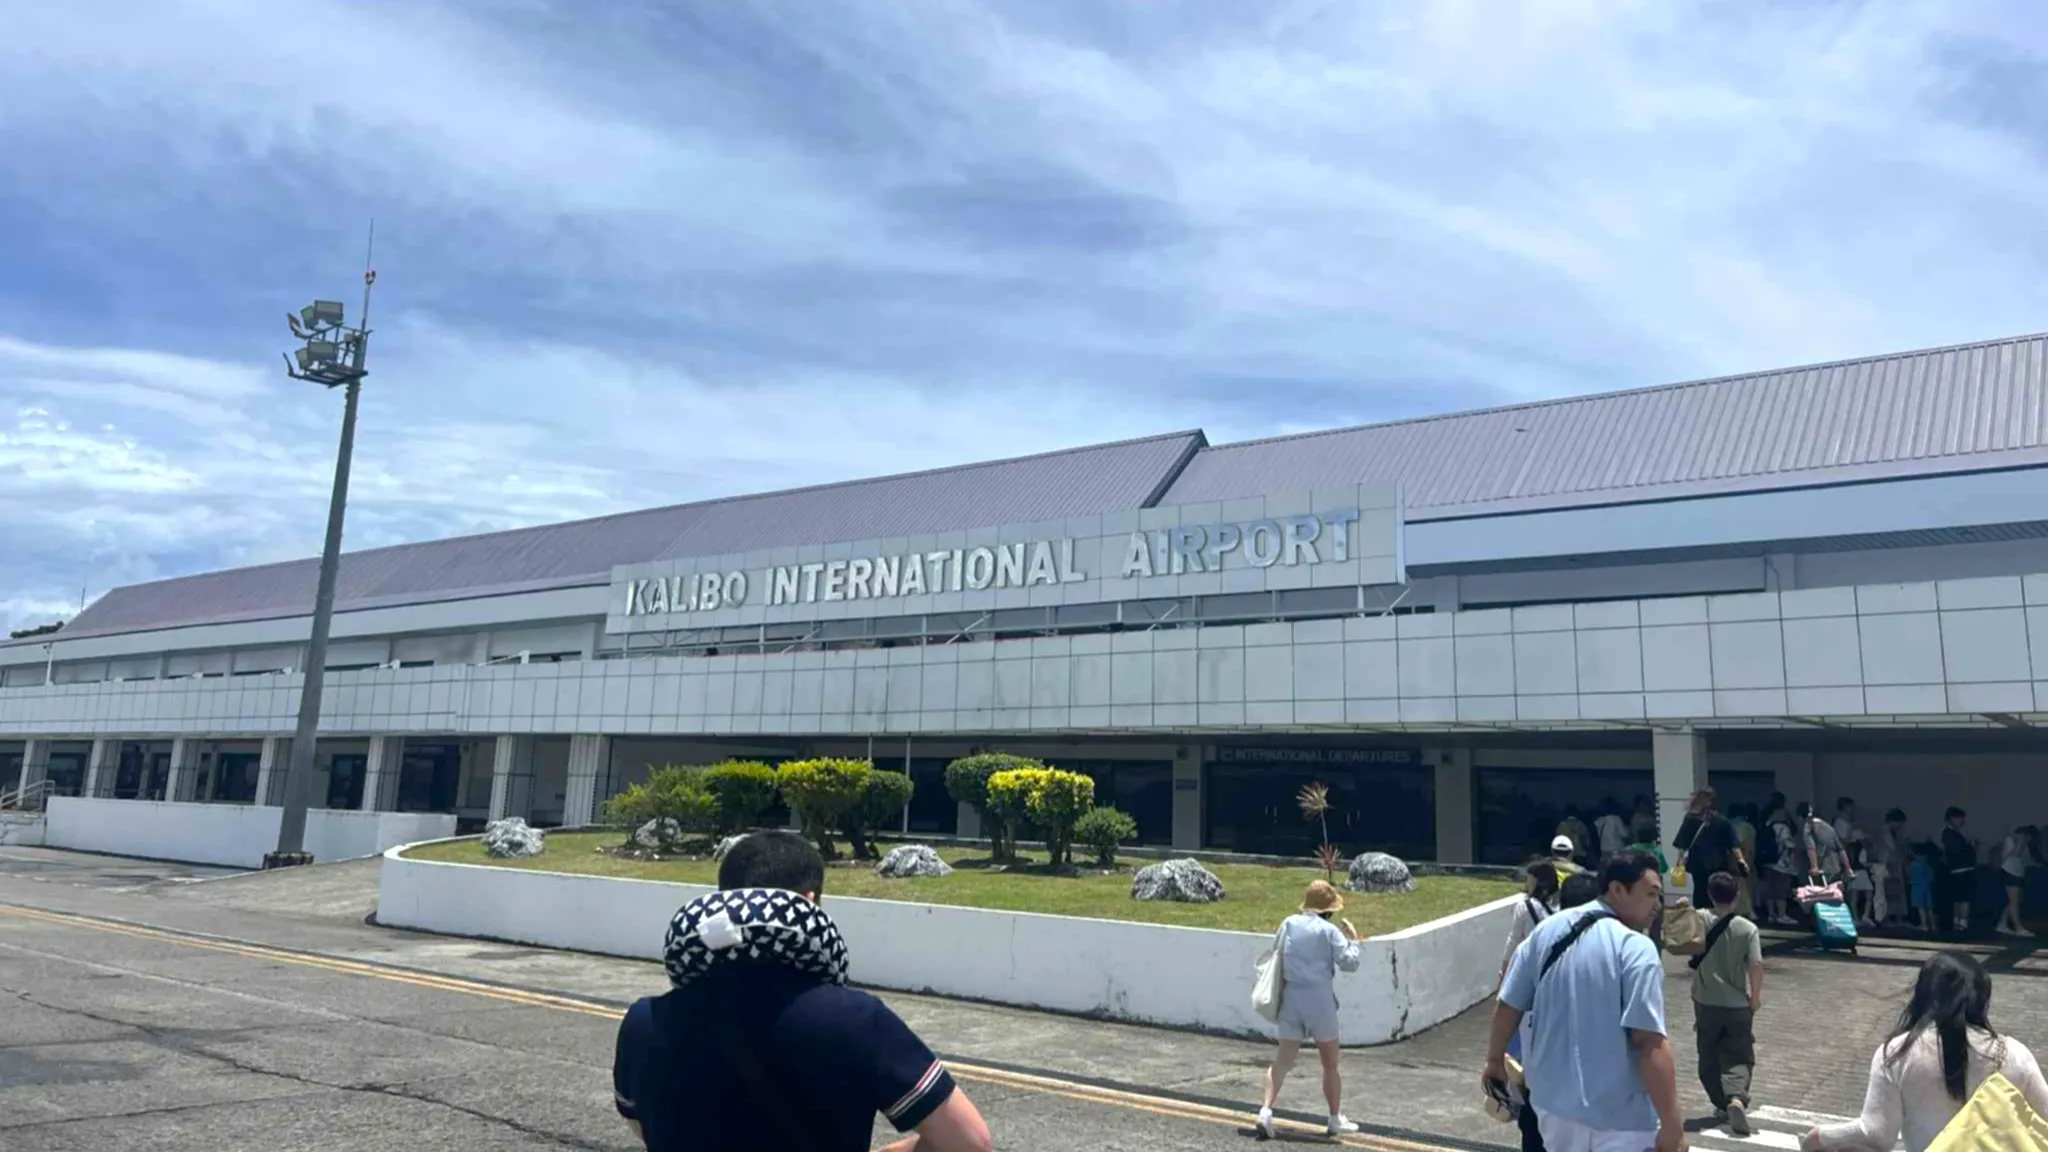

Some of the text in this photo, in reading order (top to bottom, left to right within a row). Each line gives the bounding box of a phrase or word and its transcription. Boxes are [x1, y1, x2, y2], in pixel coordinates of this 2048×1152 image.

[625, 507, 1360, 616] KALIBO INTERNATIONAL AIRPORT
[1235, 748, 1410, 763] INTERNATIONAL DEPARTURES
